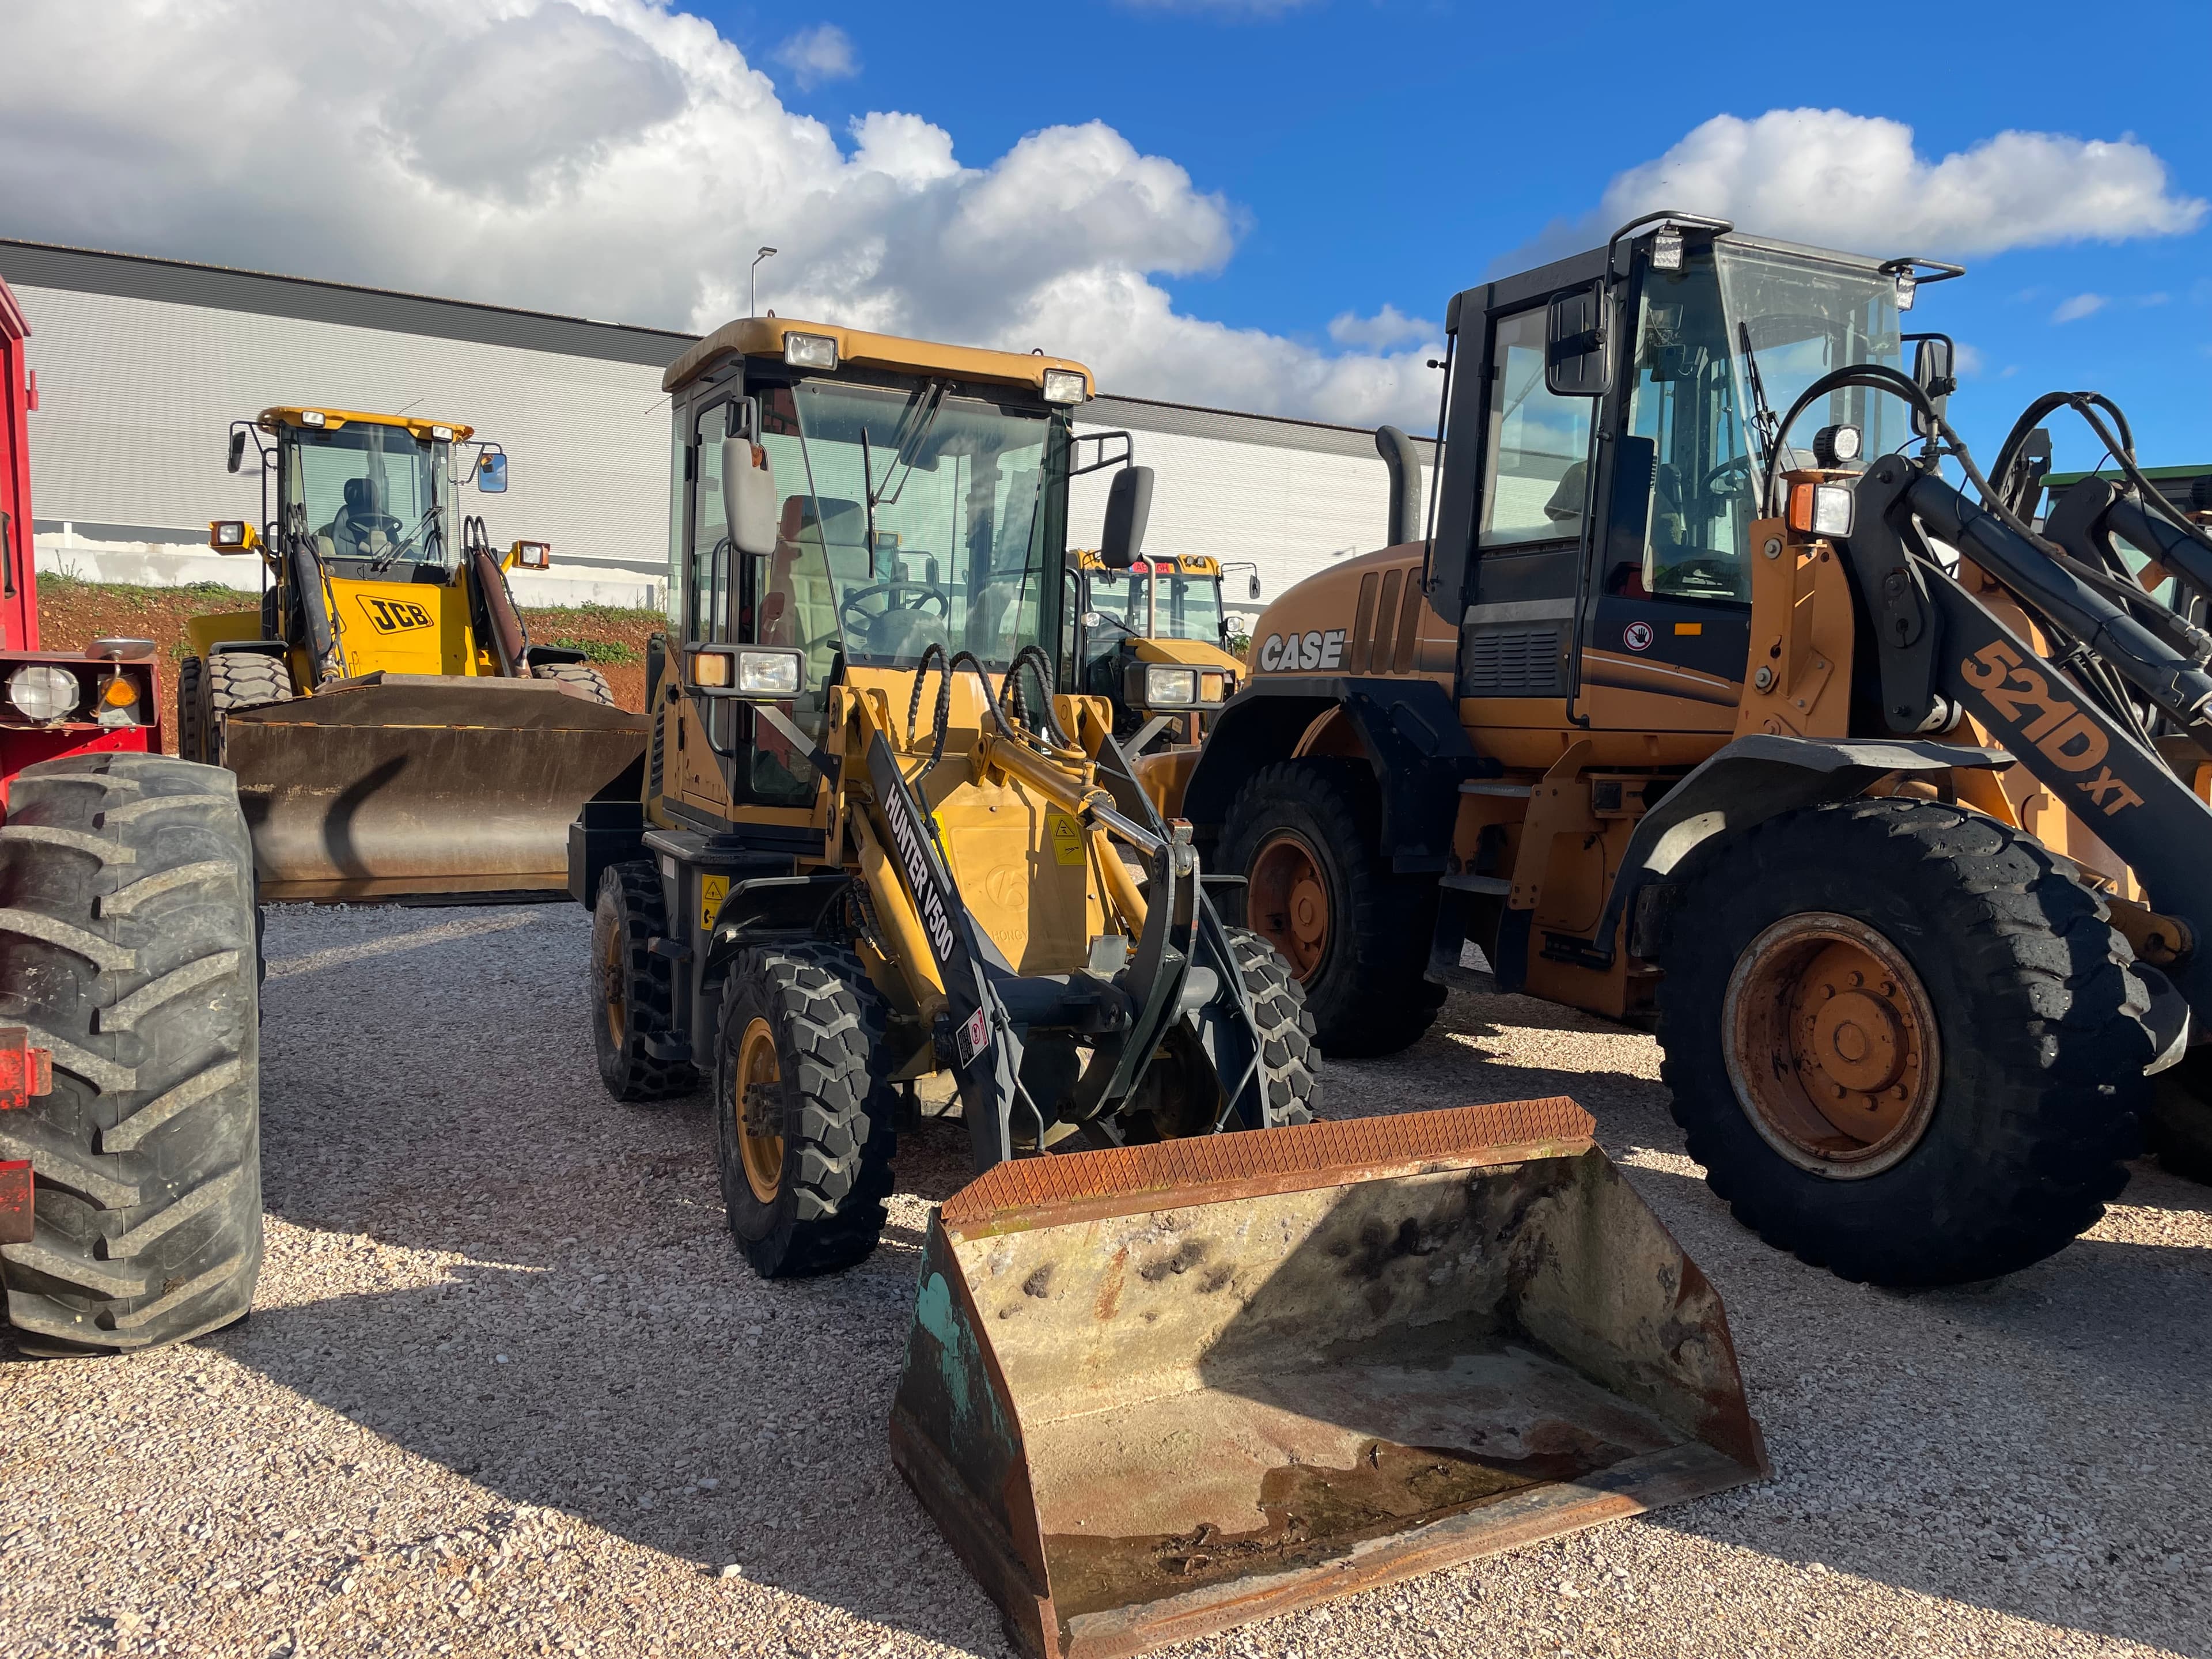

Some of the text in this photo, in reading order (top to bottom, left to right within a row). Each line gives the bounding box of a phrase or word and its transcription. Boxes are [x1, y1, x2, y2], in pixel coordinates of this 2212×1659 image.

[370, 600, 428, 630] JCB
[1260, 630, 1346, 672] CASE
[885, 782, 953, 961] HUNTER V500
